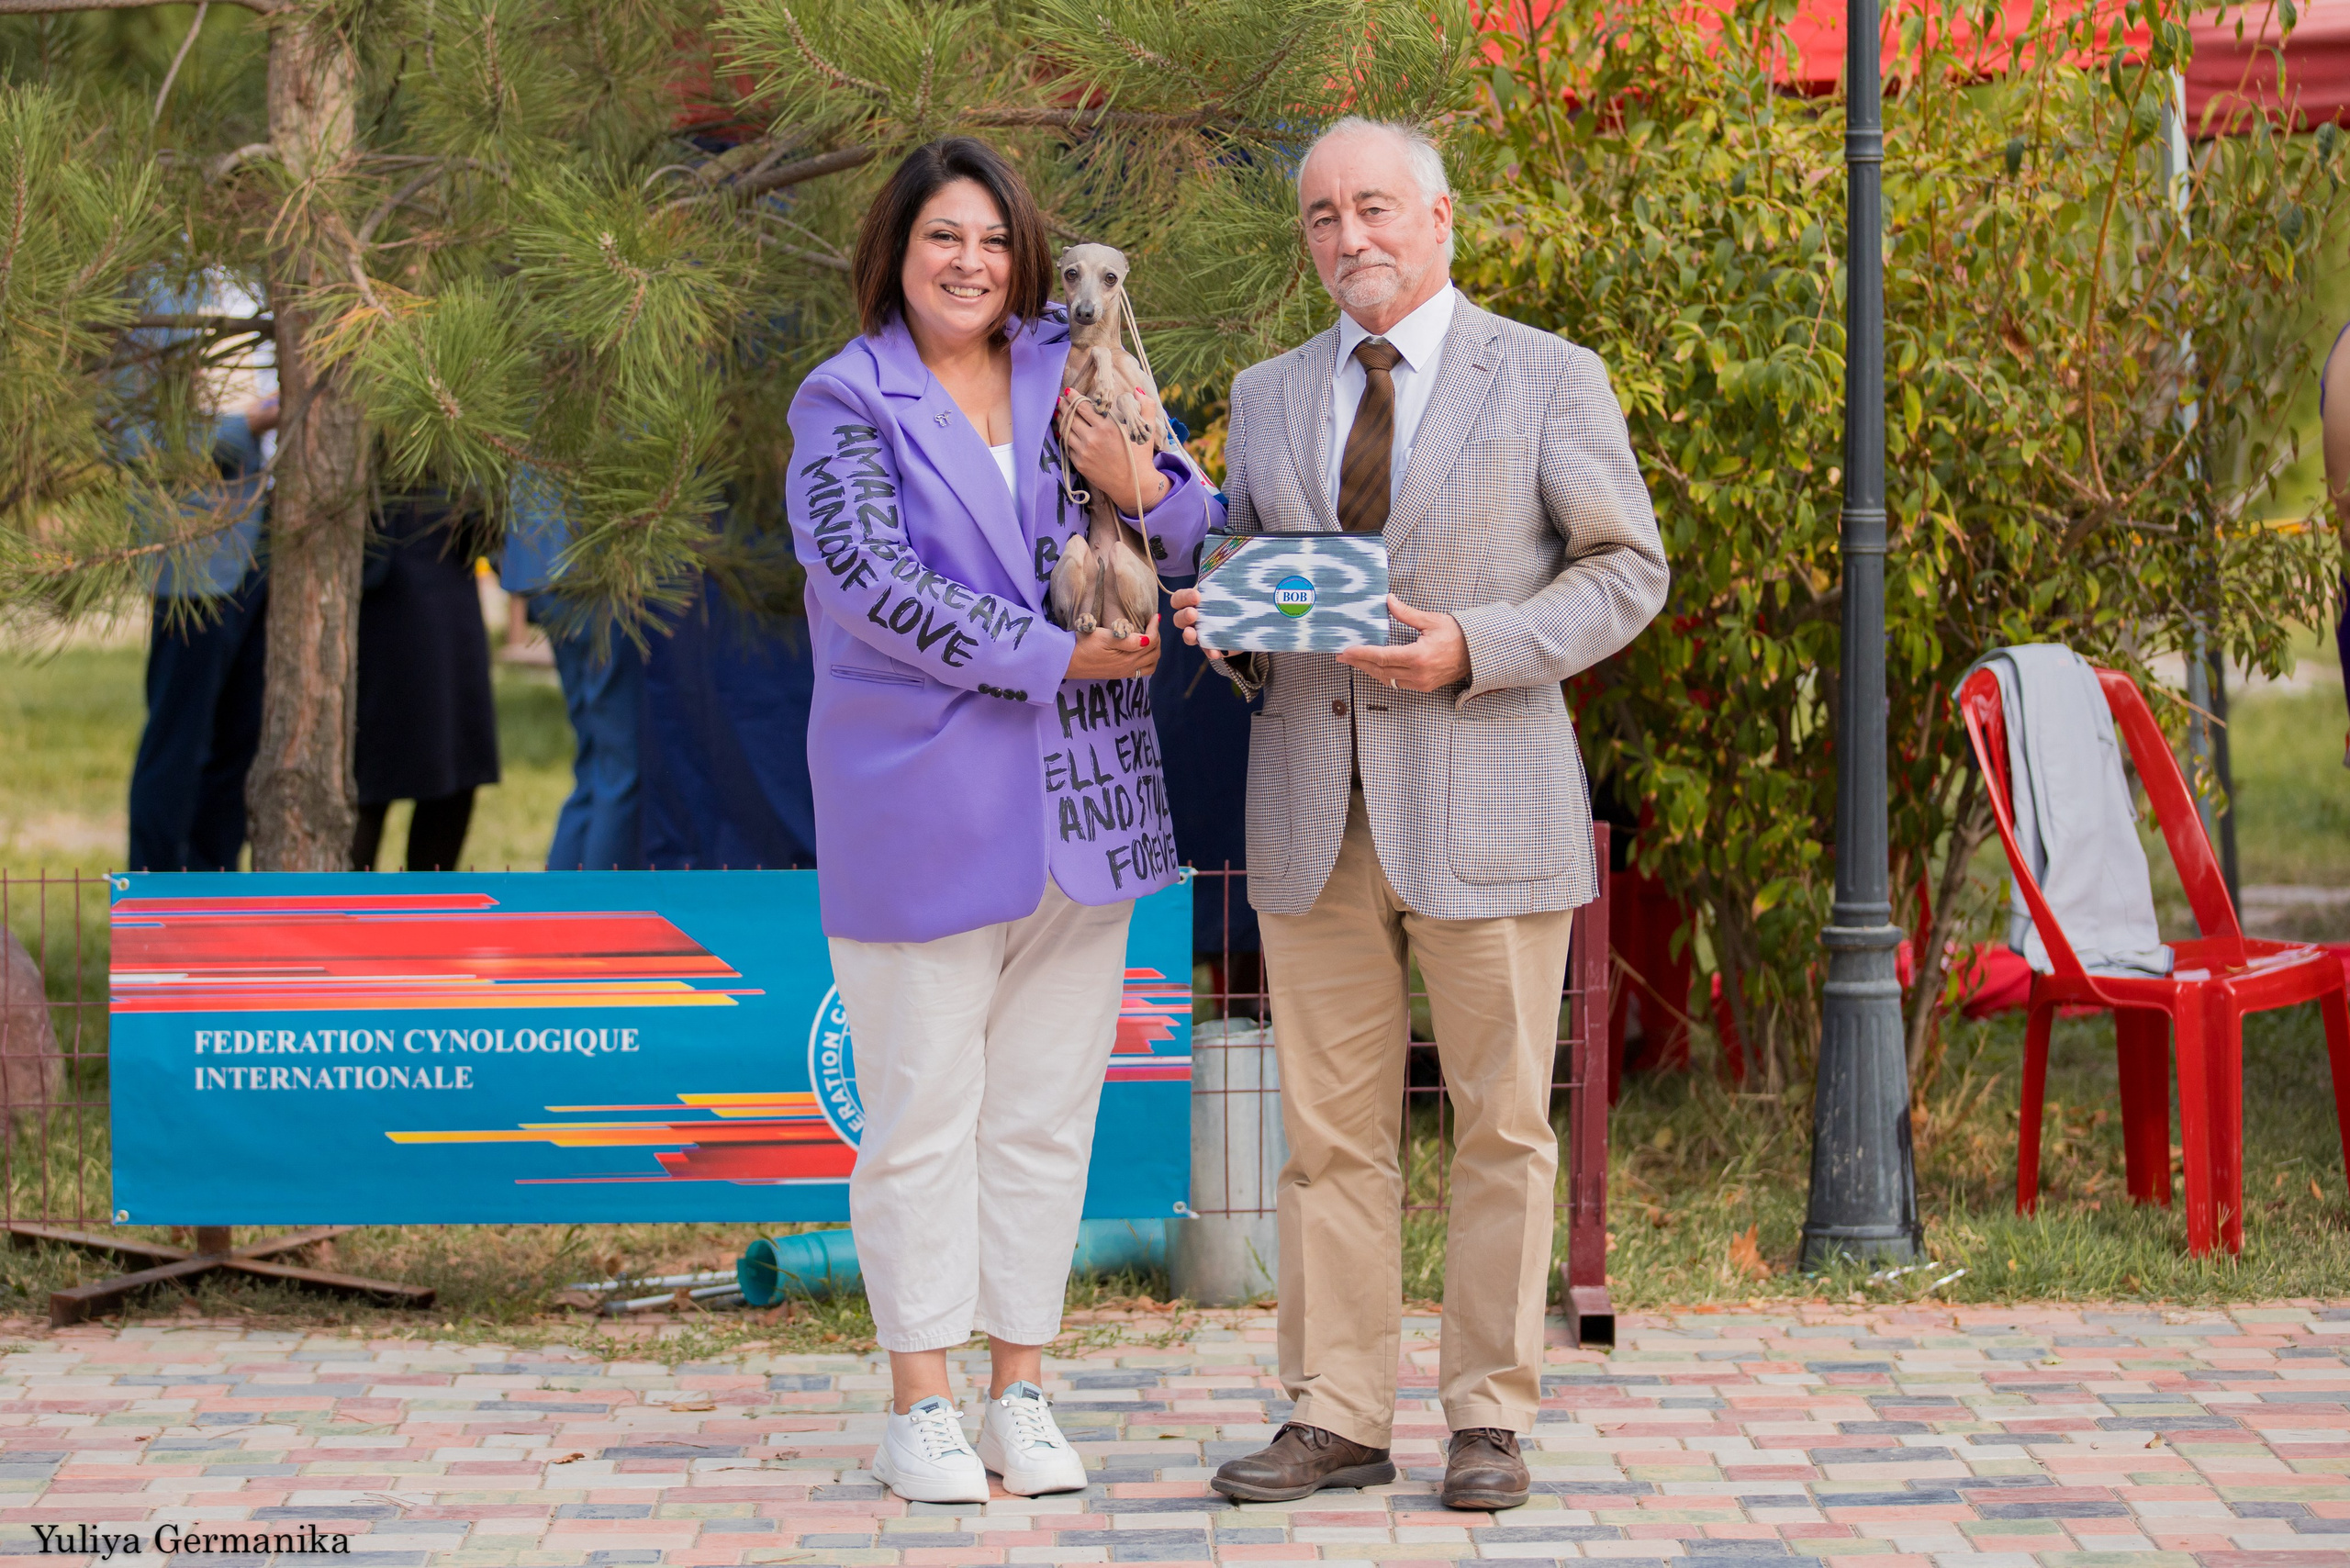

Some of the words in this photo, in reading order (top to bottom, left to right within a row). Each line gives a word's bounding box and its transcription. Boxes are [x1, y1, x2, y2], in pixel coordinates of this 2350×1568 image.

[800, 454, 853, 558] MIND
[826, 547, 878, 592] OF
[1283, 591, 1307, 602] BOB
[867, 585, 979, 667] LOVE
[1058, 784, 1134, 843] AND
[195, 1029, 395, 1054] FEDERATION
[403, 1027, 640, 1057] CYNOLOGIQUE
[195, 1065, 474, 1091] INTERNATIONALE
